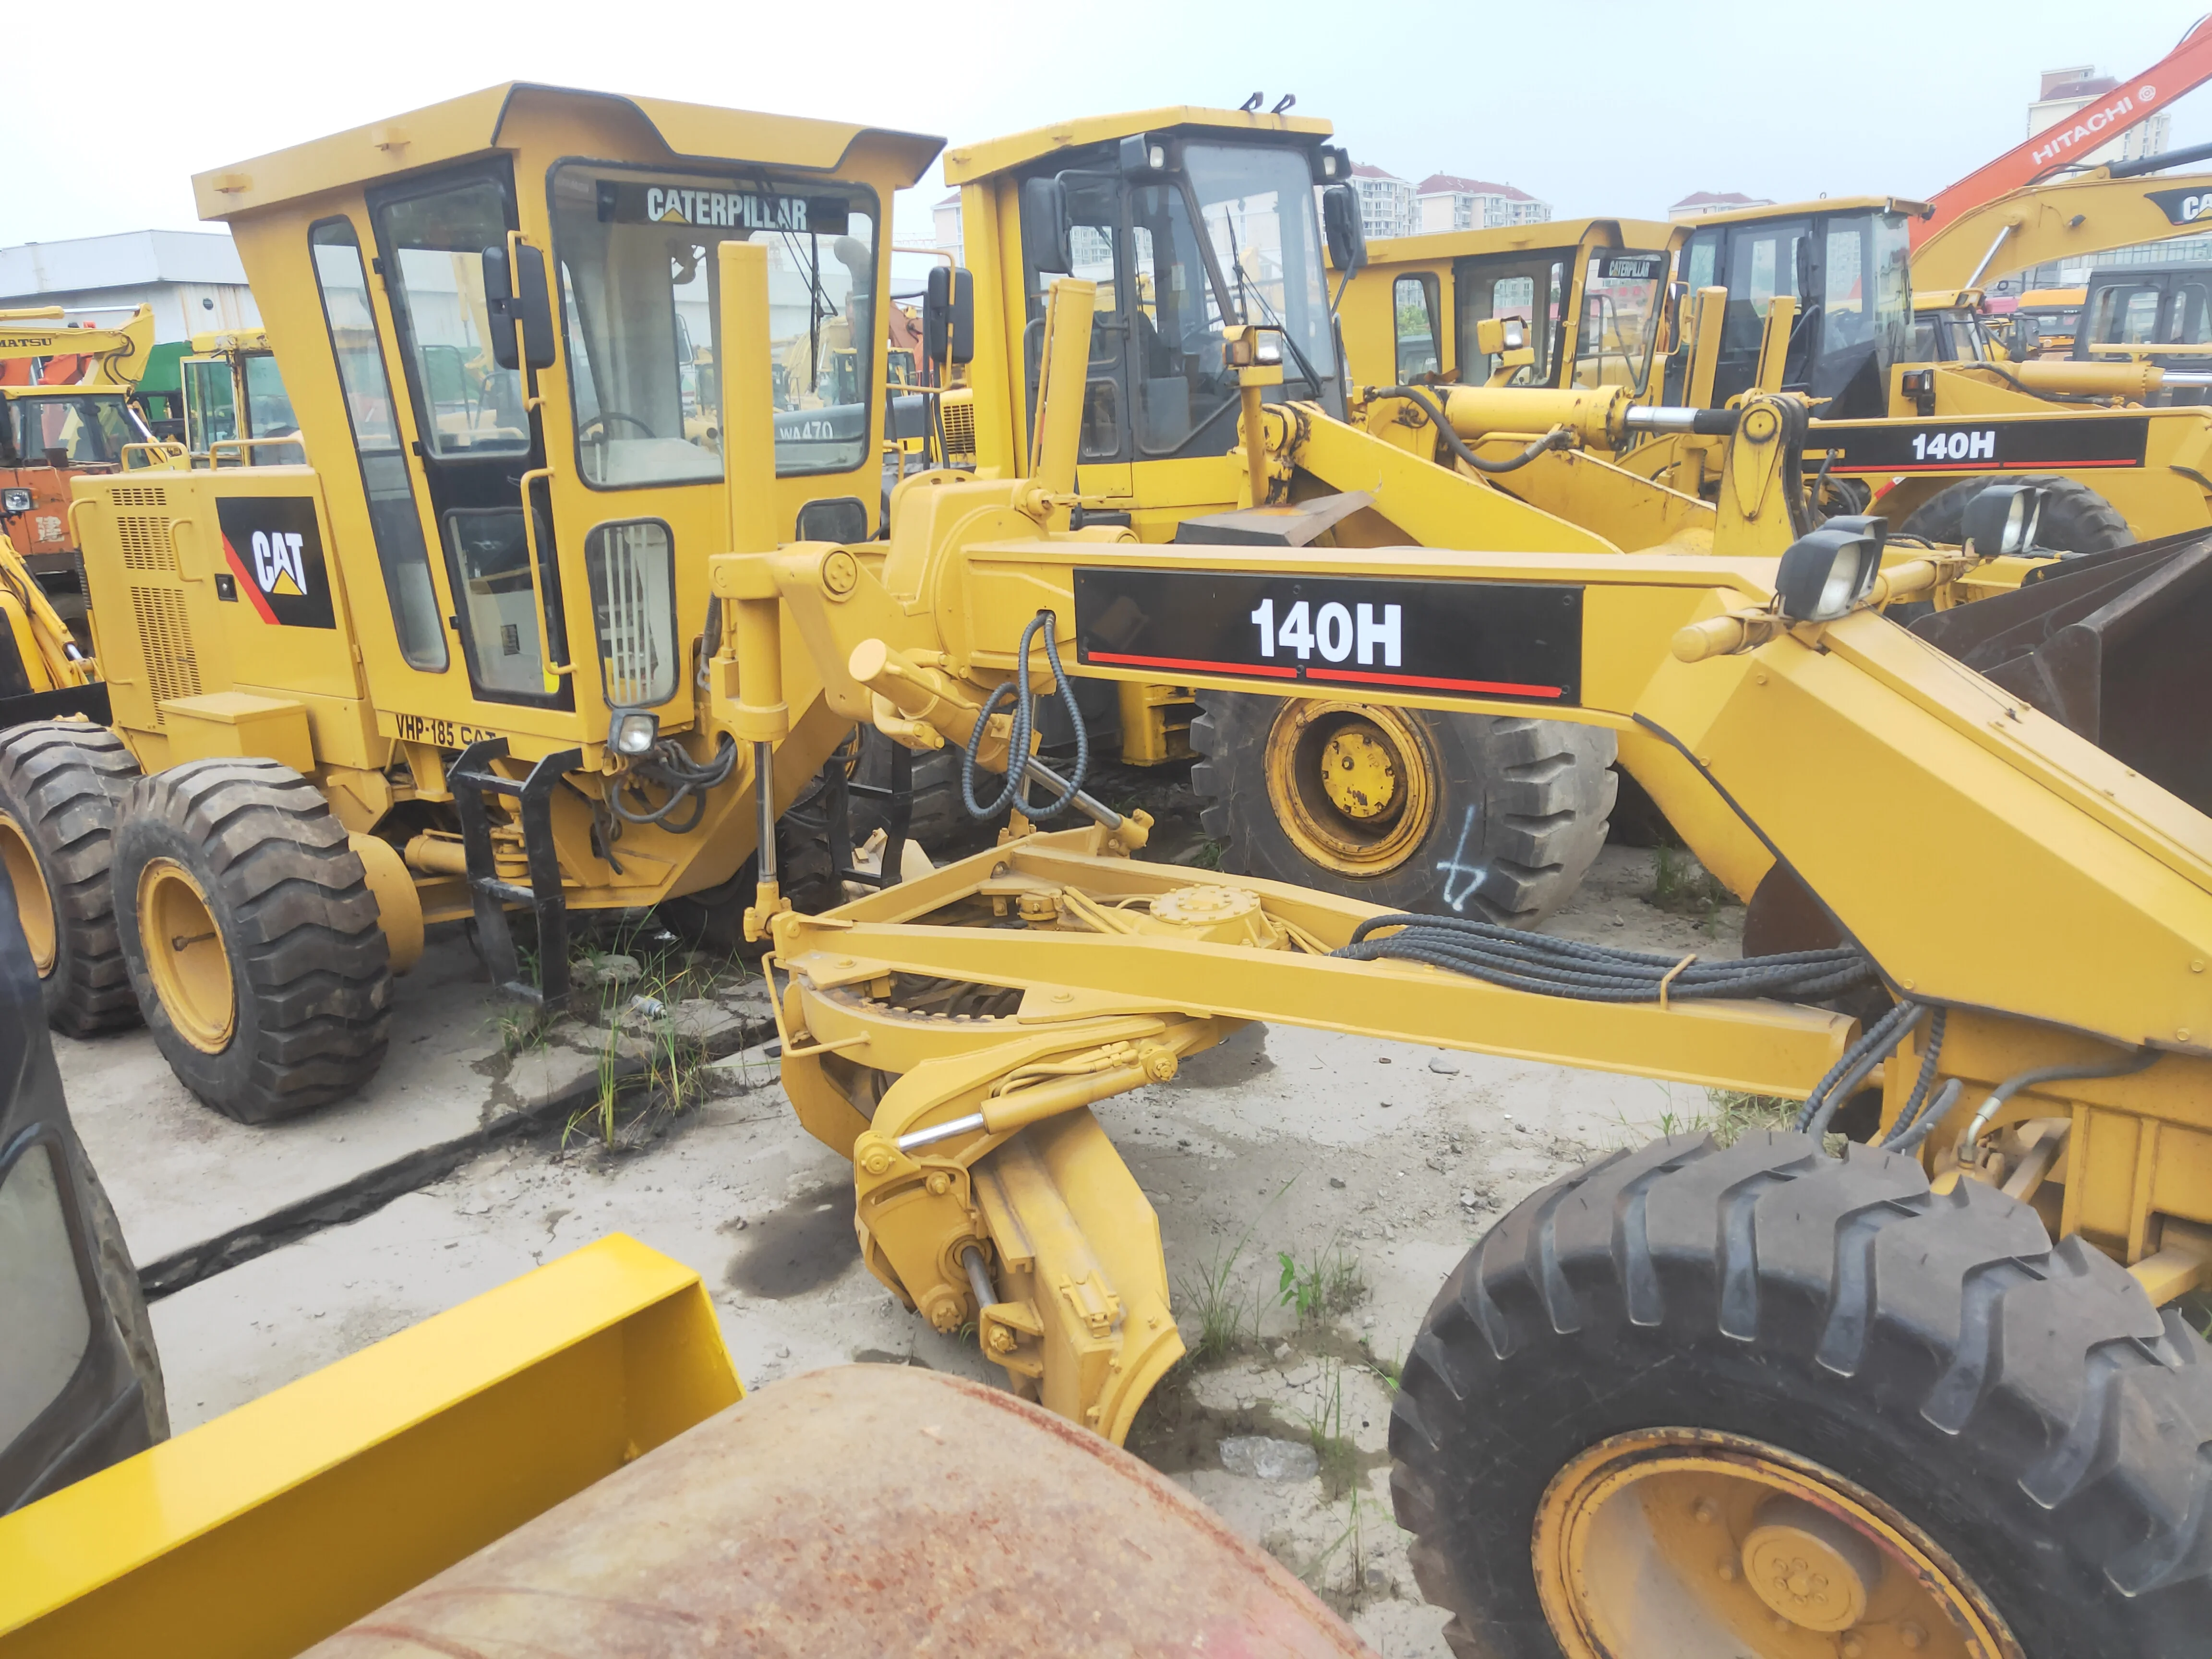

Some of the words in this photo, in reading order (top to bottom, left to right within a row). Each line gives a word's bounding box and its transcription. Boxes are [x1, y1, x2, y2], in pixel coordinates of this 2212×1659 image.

[2032, 96, 2134, 165] HITACHI
[647, 188, 807, 230] CATERPILLAR
[1609, 260, 1650, 277] CATERPILLAR
[779, 421, 833, 440] WA470
[1912, 431, 1996, 460] 140H
[252, 530, 307, 595] CAT
[1251, 599, 1402, 667] 140H
[396, 714, 454, 746] VHP-185
